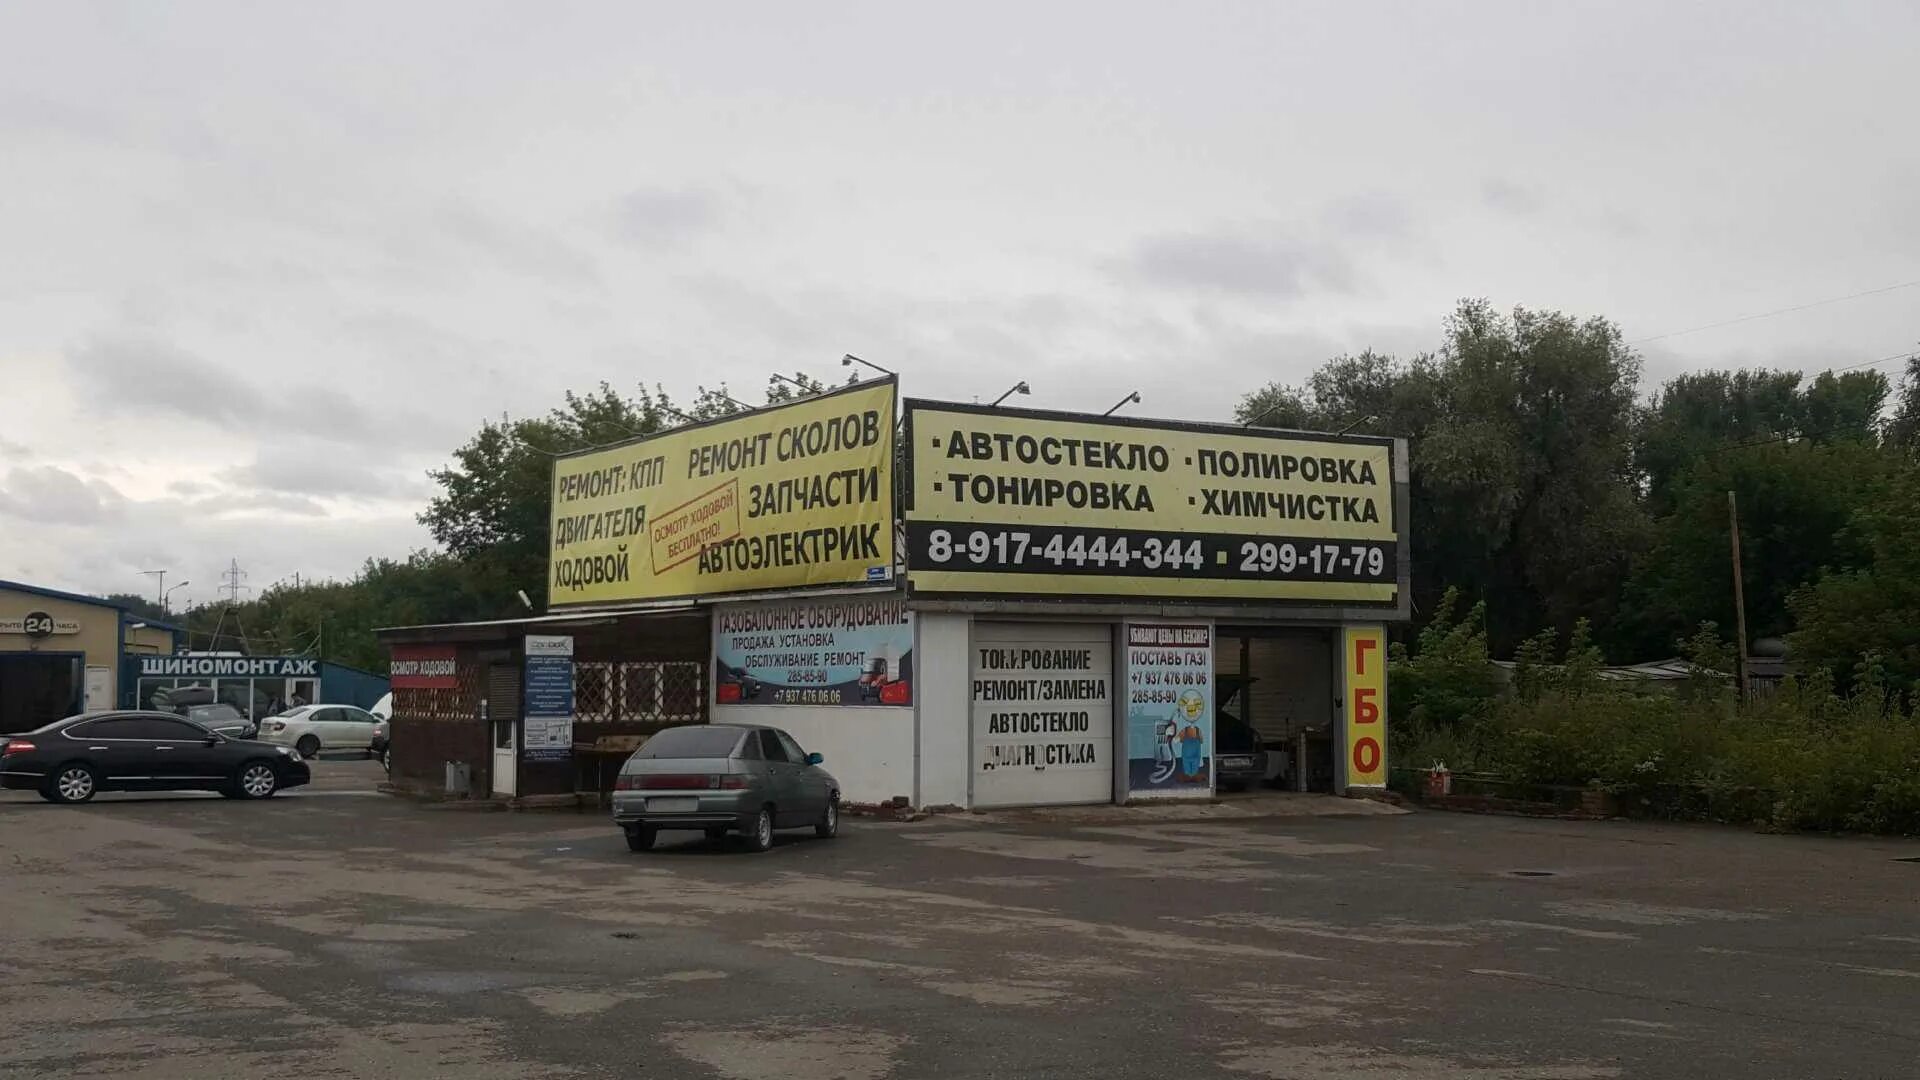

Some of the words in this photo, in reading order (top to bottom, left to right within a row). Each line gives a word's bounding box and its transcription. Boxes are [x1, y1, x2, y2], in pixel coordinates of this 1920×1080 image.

[687, 432, 772, 479] РЕМОНТ
[777, 410, 880, 462] СКОЛОВ
[946, 430, 1169, 472] АВТОСТЕКЛО
[1198, 449, 1377, 485] ПОЛИРОВКА
[559, 465, 626, 502] РЕМОНТ:
[629, 456, 665, 490] КПП
[748, 466, 879, 518] ЗАПЧАСТИ
[654, 517, 688, 543] ОСМОТР
[690, 488, 735, 523] ХОДОВОЙ
[948, 473, 1155, 512] ТОНИРОВКА
[1201, 488, 1379, 523] ХИМЧИСТКА
[555, 505, 646, 551] ДВИГАТЕЛЯ
[667, 521, 721, 558] БЕСПЛАТНО!
[698, 523, 881, 574] АВТОЭЛЕКТРИК
[928, 529, 1204, 570] 8-917-4444-344
[1239, 542, 1384, 576] 299-17-79
[554, 544, 629, 591] ХОДОВОЙ
[26, 618, 51, 632] 24
[719, 607, 805, 635] ГАЗОБАЛОННОЕ
[808, 601, 909, 631] ОБОРУДОВАНИЕ
[732, 635, 775, 651] ПРОДАЖА
[779, 633, 835, 649] УСТАНОВКА
[1131, 651, 1182, 665] ПОСТАВЬ
[141, 658, 318, 675] ШИНОМОНТАЖ
[391, 661, 418, 675] ОСМОТР
[420, 656, 456, 677] ХОДОВОЙ
[745, 652, 819, 668] ОБСЛУЖИВАНИЕ
[824, 652, 866, 666] РЕМОНТ
[973, 679, 1106, 701] РЕМОНТ/ЗАМЕНА
[1131, 671, 1143, 685] +7
[1145, 671, 1161, 685] 937
[1164, 671, 1180, 685] 476
[1182, 671, 1194, 685] 06
[1195, 671, 1207, 685] 06
[774, 690, 785, 702] +7
[786, 690, 801, 702] 937
[802, 690, 817, 702] 476
[818, 690, 829, 703] 06
[830, 690, 841, 703] 06
[1132, 689, 1177, 703] 285-85-90
[1353, 639, 1380, 774] ГБО
[988, 711, 1089, 734] АВТОСТЕКЛО
